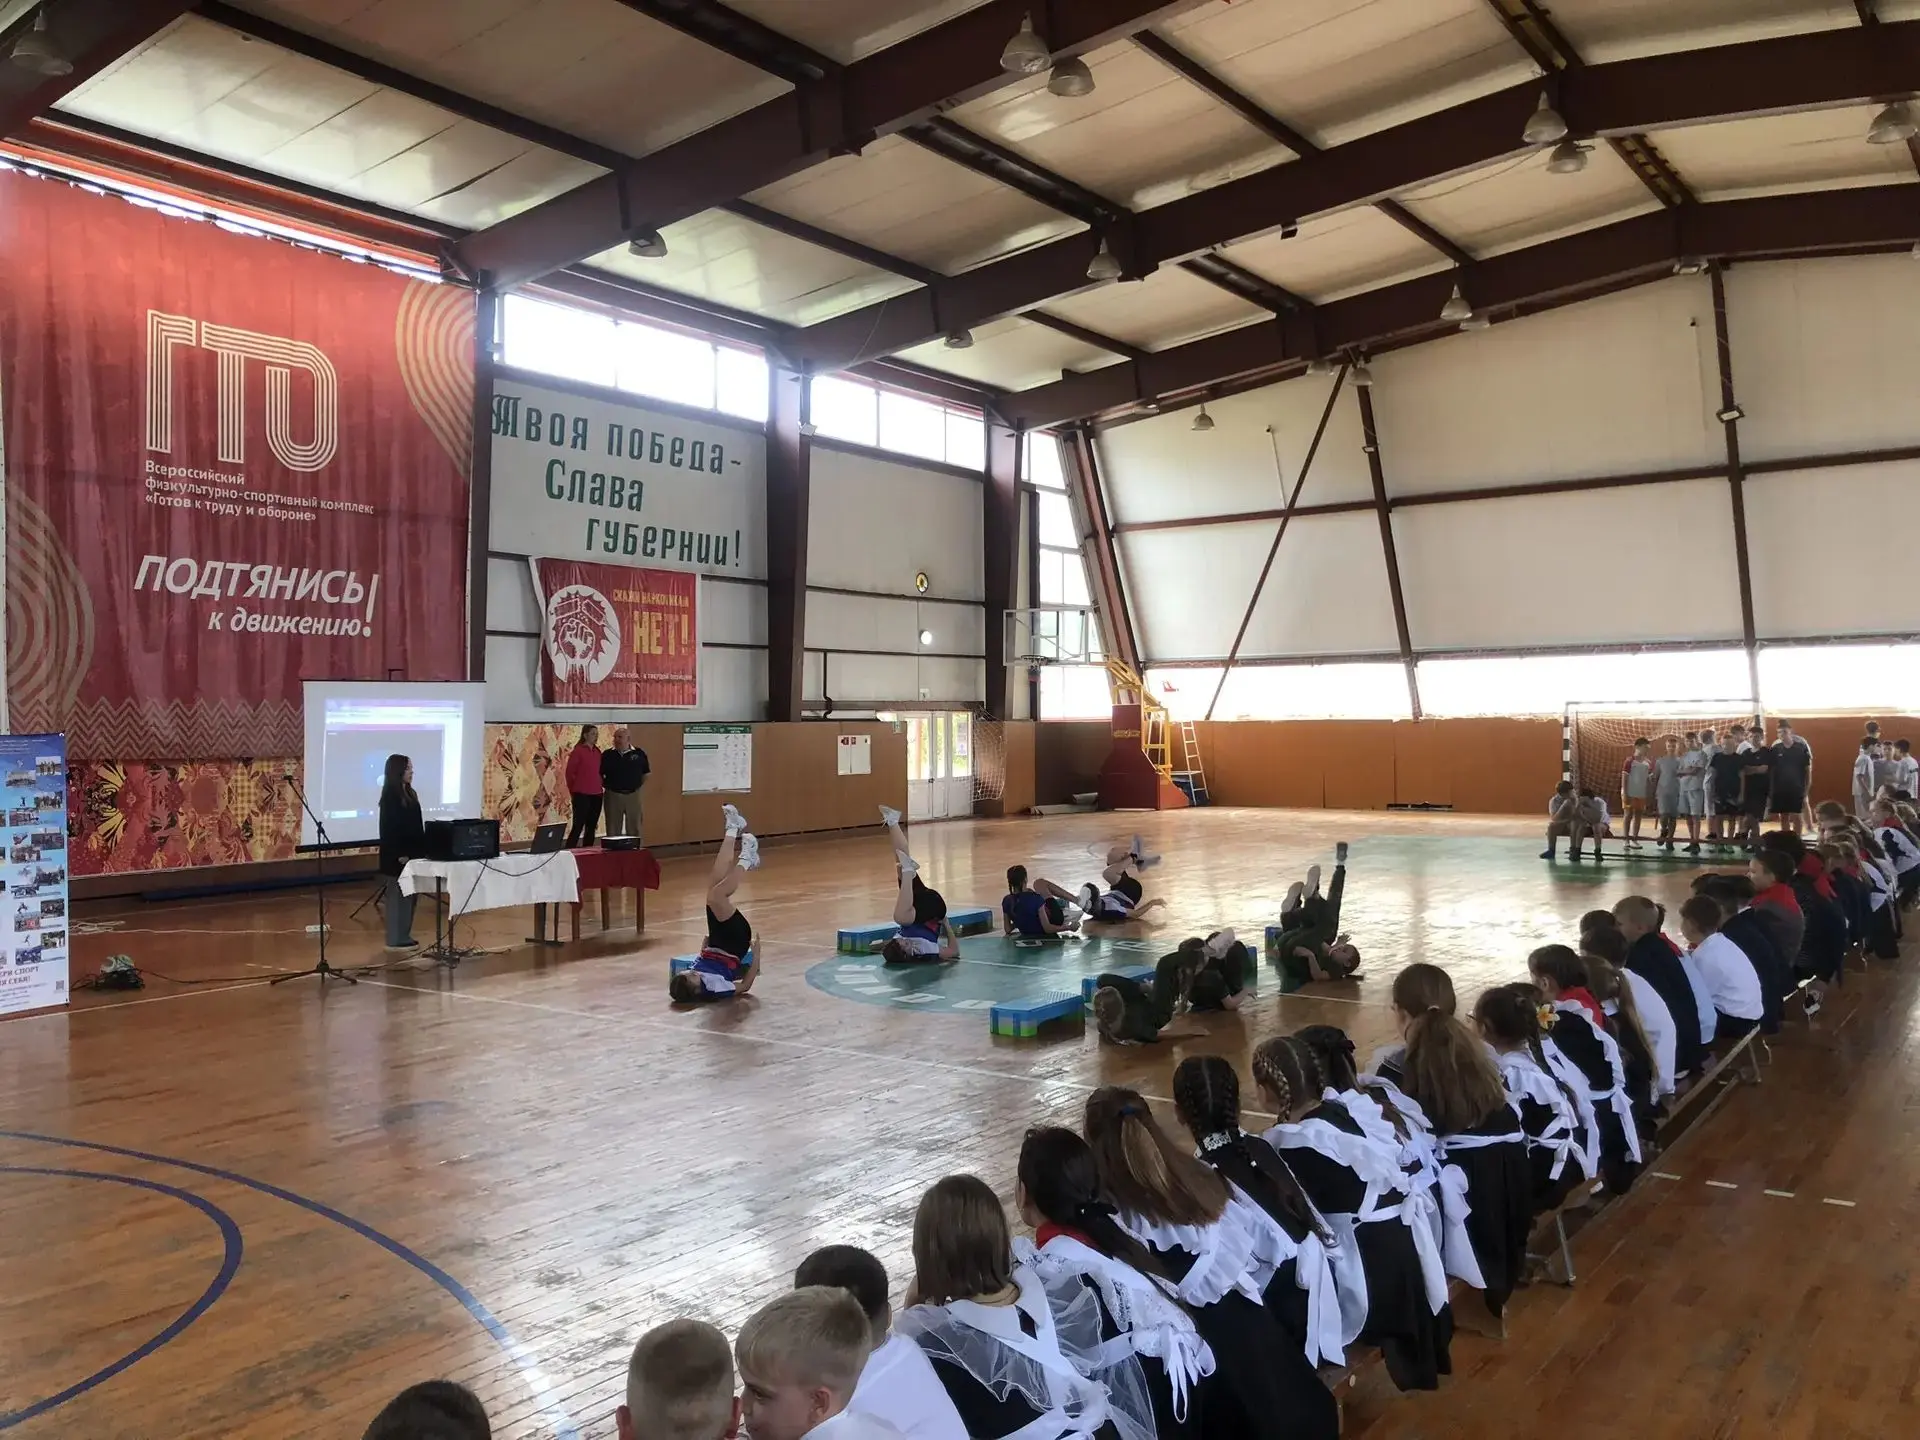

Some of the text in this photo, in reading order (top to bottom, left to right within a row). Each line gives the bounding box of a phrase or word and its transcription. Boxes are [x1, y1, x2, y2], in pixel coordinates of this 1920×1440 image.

[146, 309, 338, 472] ГТО
[491, 393, 588, 451] Твоя
[145, 459, 245, 485] Всероссийский
[545, 458, 644, 512] Слава
[145, 476, 375, 515] физкультурно-спортивный комплекс
[145, 491, 192, 508] «Готов
[195, 500, 202, 509] к
[204, 501, 242, 517] труду
[246, 506, 254, 516] и
[208, 611, 224, 630] к
[633, 610, 689, 656] НЕТ!
